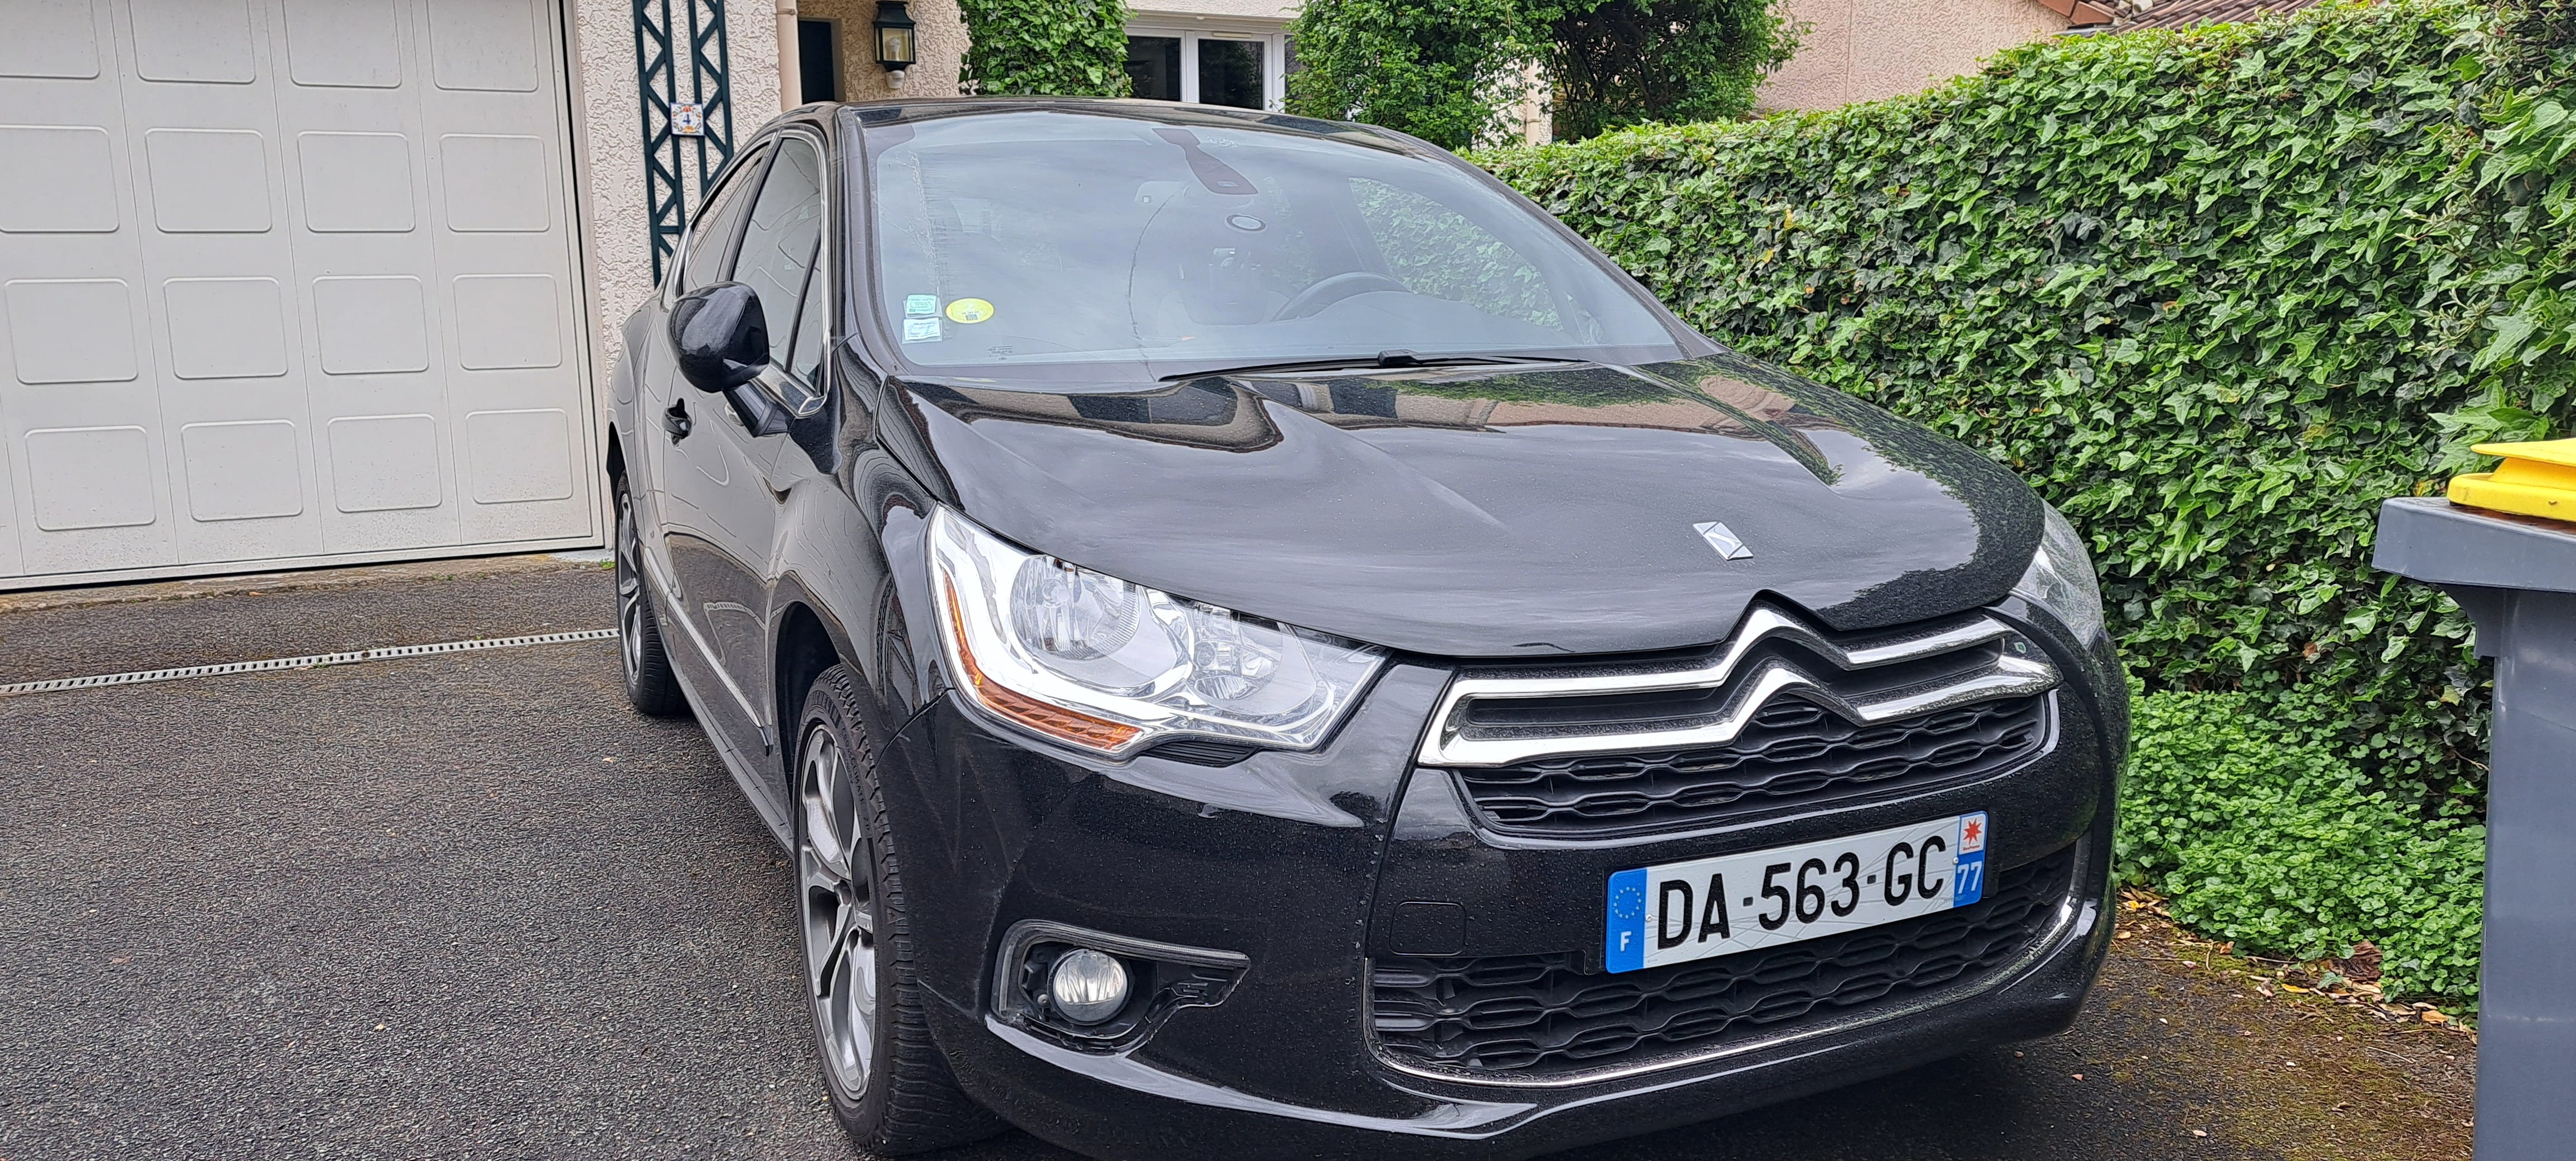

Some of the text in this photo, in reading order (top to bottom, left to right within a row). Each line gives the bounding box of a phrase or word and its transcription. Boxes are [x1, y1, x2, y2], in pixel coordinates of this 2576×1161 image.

[682, 114, 691, 125] 4
[1957, 861, 1983, 895] 77
[1657, 835, 1946, 950] DA-563-GC
[1620, 931, 1631, 952] F
